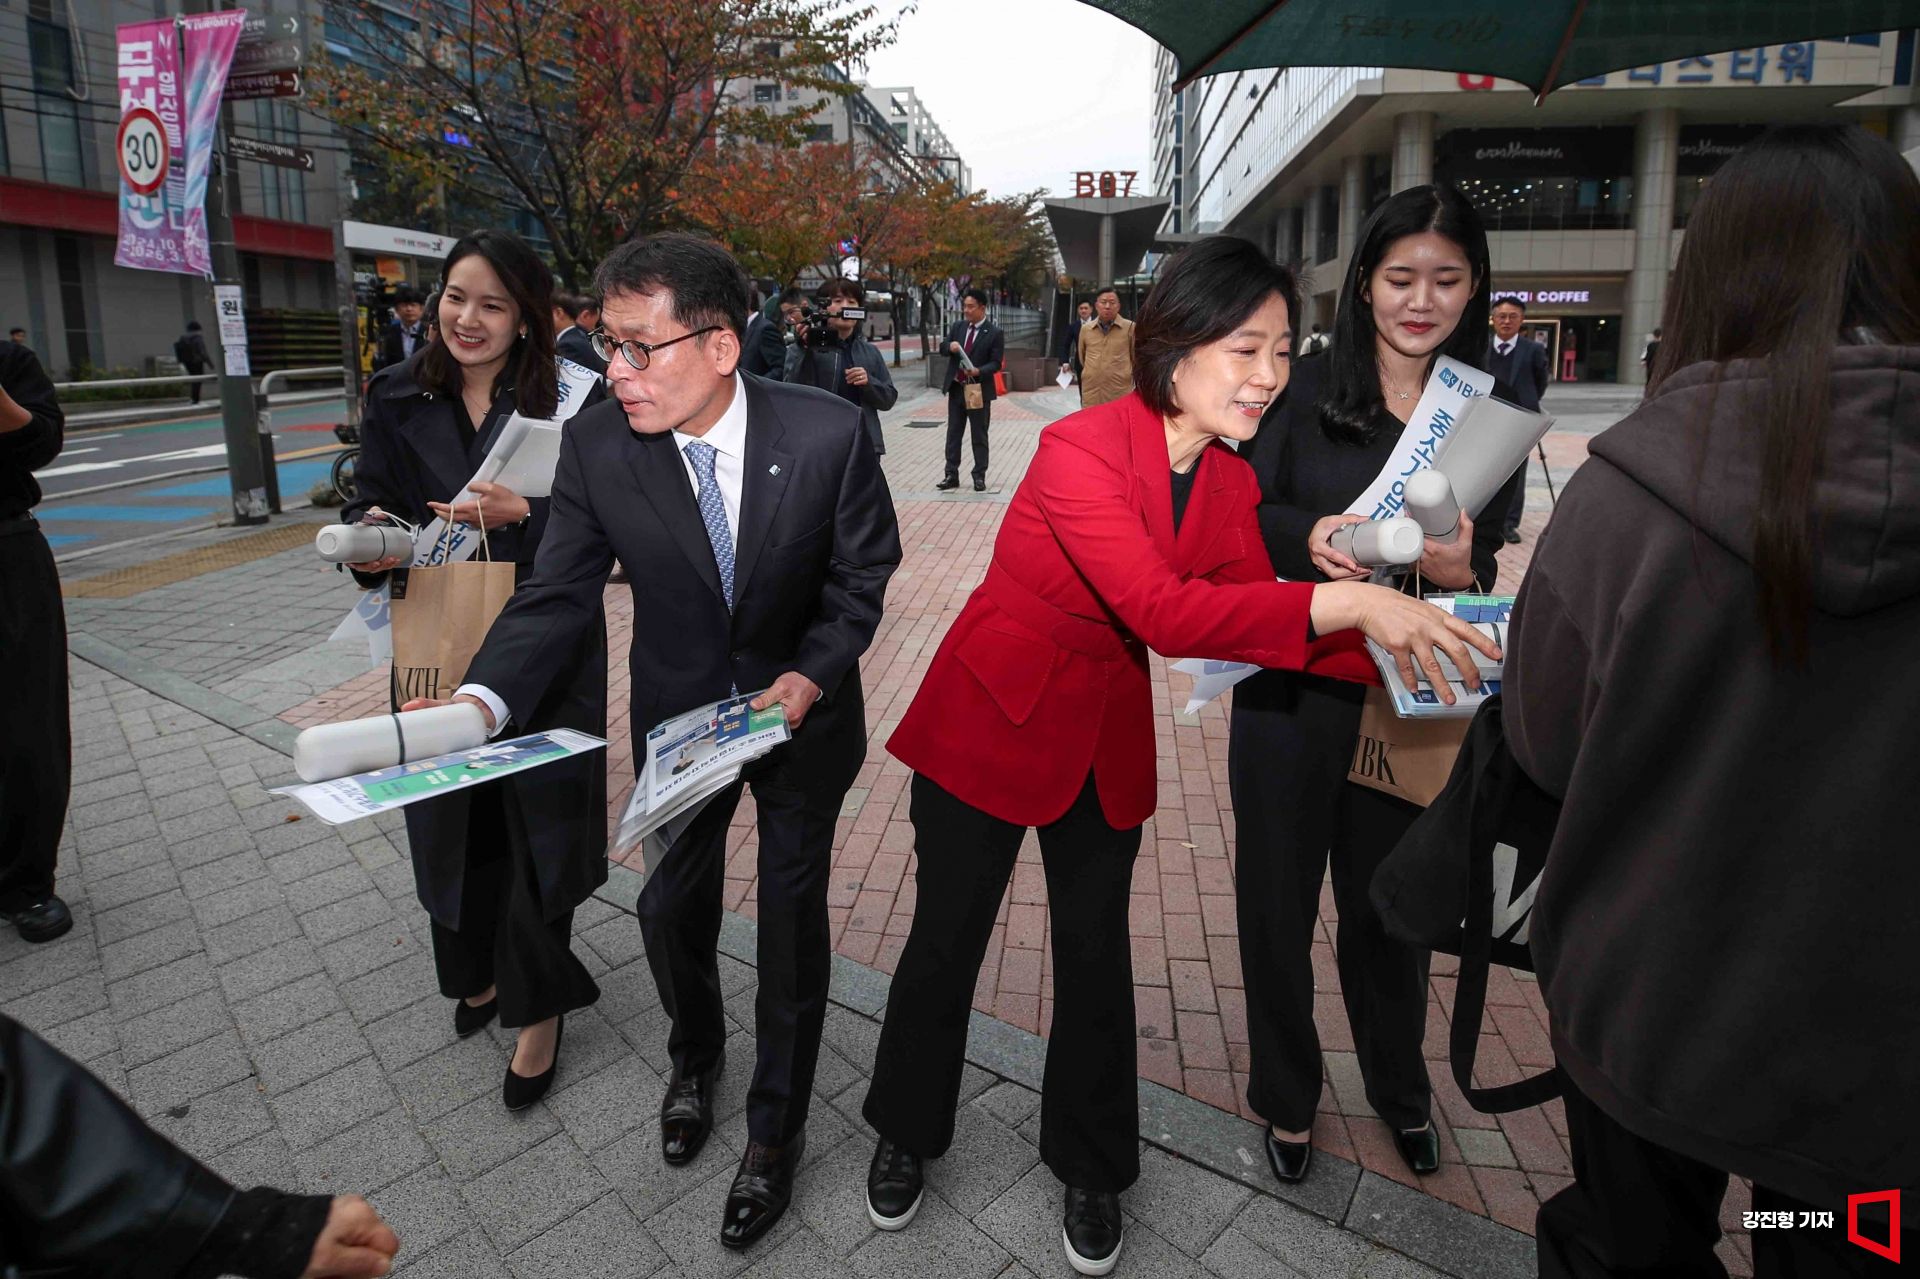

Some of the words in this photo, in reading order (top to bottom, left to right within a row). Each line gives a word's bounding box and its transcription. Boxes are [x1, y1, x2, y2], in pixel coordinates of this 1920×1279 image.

[1576, 42, 1816, 87] 스타워
[126, 132, 158, 172] 30
[1076, 171, 1137, 198] B07
[1537, 291, 1590, 302] COFFEE
[1351, 734, 1400, 787] IBK
